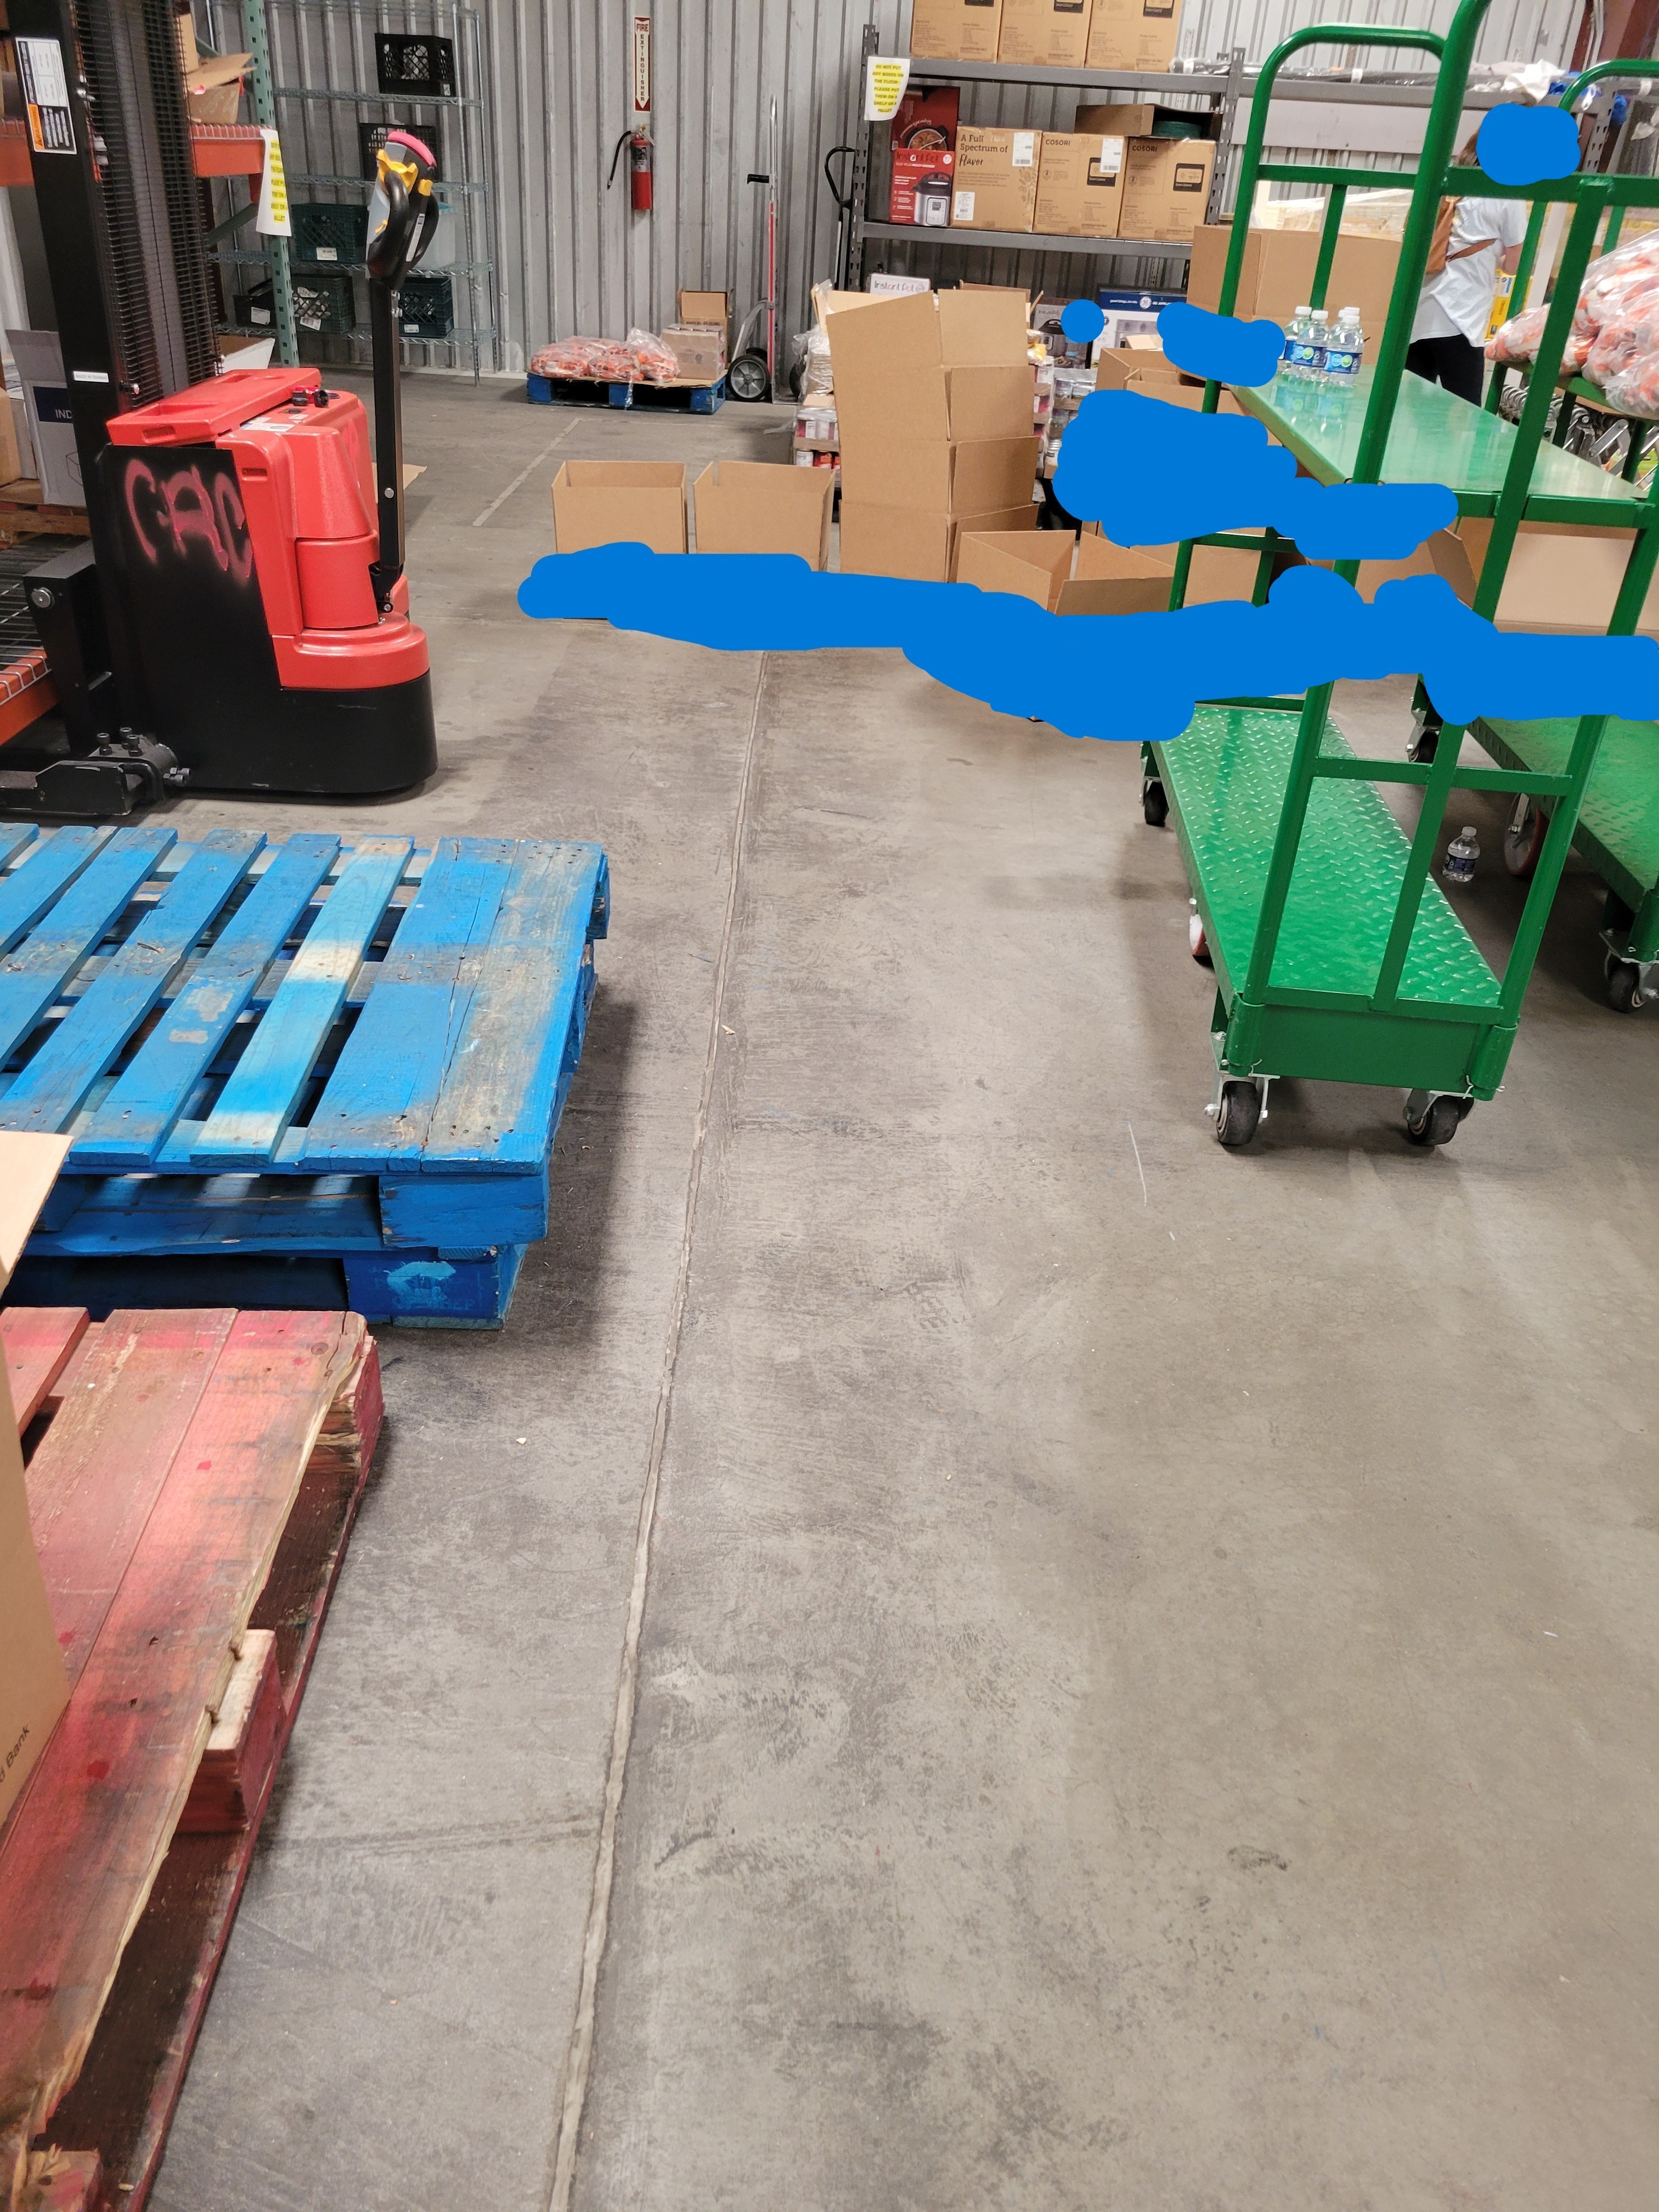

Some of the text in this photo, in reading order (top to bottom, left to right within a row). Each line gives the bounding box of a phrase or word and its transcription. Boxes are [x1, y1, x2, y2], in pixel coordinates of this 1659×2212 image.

[636, 23, 648, 32] FIRE
[969, 134, 984, 143] Full
[960, 143, 997, 153] Spectrum
[959, 154, 984, 167] Flavor
[874, 280, 914, 292] Instant Pot
[6, 1724, 30, 1769] Bank
